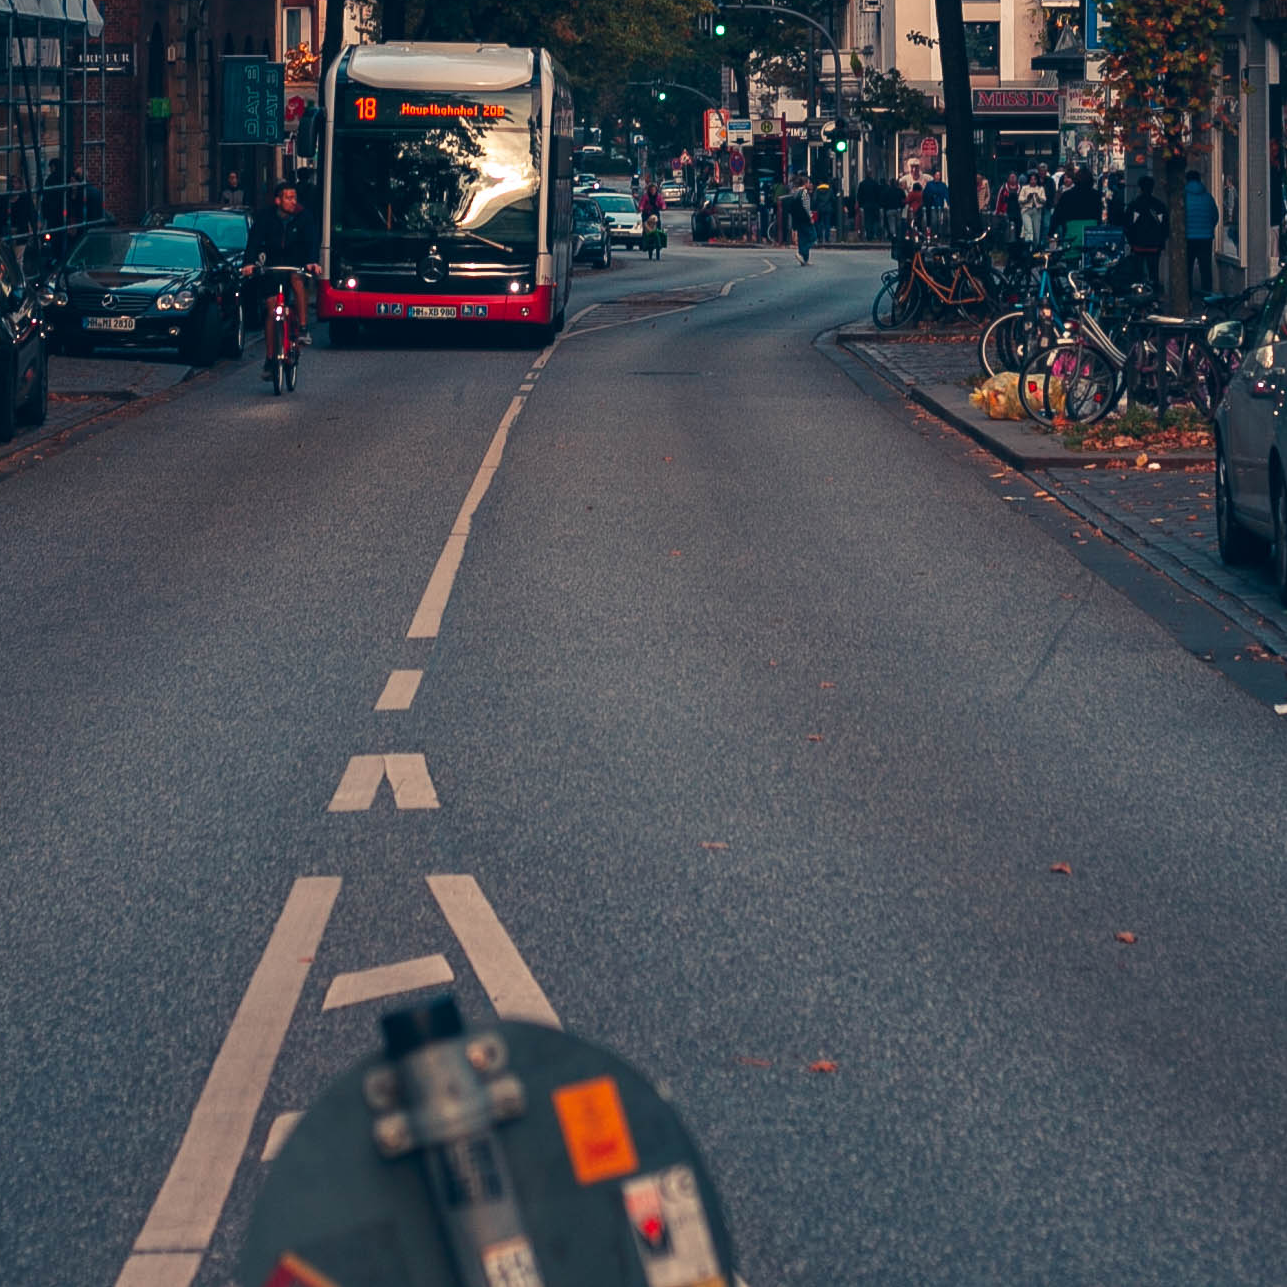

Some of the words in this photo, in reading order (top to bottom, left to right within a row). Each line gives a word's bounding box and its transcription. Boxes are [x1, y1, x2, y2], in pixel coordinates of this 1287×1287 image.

[353, 96, 378, 121] 18
[400, 102, 479, 117] Hauptbahnhof
[977, 90, 1028, 107] MISS
